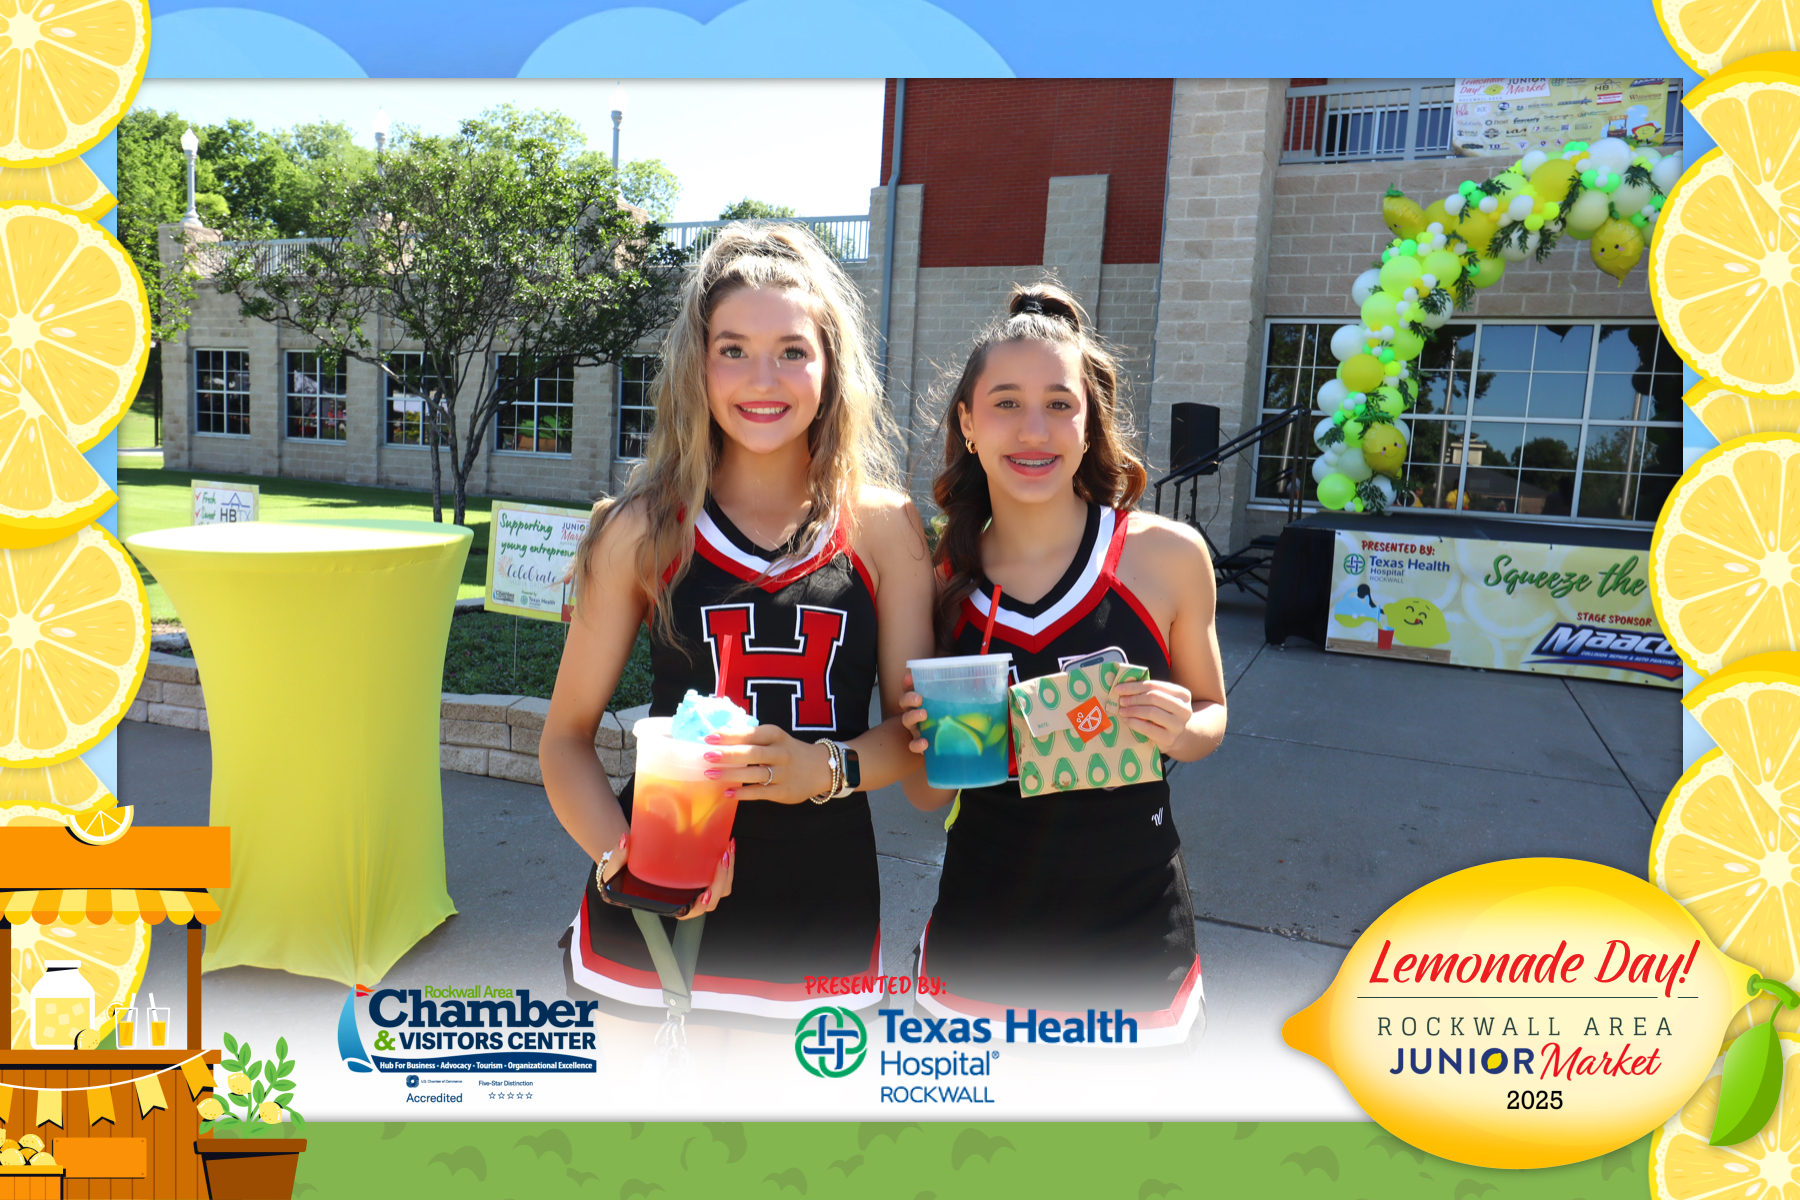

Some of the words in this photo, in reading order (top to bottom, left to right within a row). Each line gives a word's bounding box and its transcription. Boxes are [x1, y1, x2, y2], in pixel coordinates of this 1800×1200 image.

[1506, 83, 1546, 95] Market
[500, 512, 553, 541] Supporting
[501, 541, 528, 558] young
[529, 542, 576, 562] entreprene
[1361, 540, 1417, 554] PRESENTED
[1419, 544, 1435, 556] BY:
[1369, 555, 1404, 569] Texas
[1407, 558, 1450, 573] Health
[1370, 567, 1404, 577] Hospital
[507, 563, 557, 584] Celebrate
[1369, 575, 1405, 584] ROCKWALL
[1483, 554, 1593, 599] Squeeze
[1597, 554, 1648, 598] the
[1576, 611, 1607, 624] STAGE
[1608, 613, 1653, 628] SPONSOR
[701, 603, 848, 732] H
